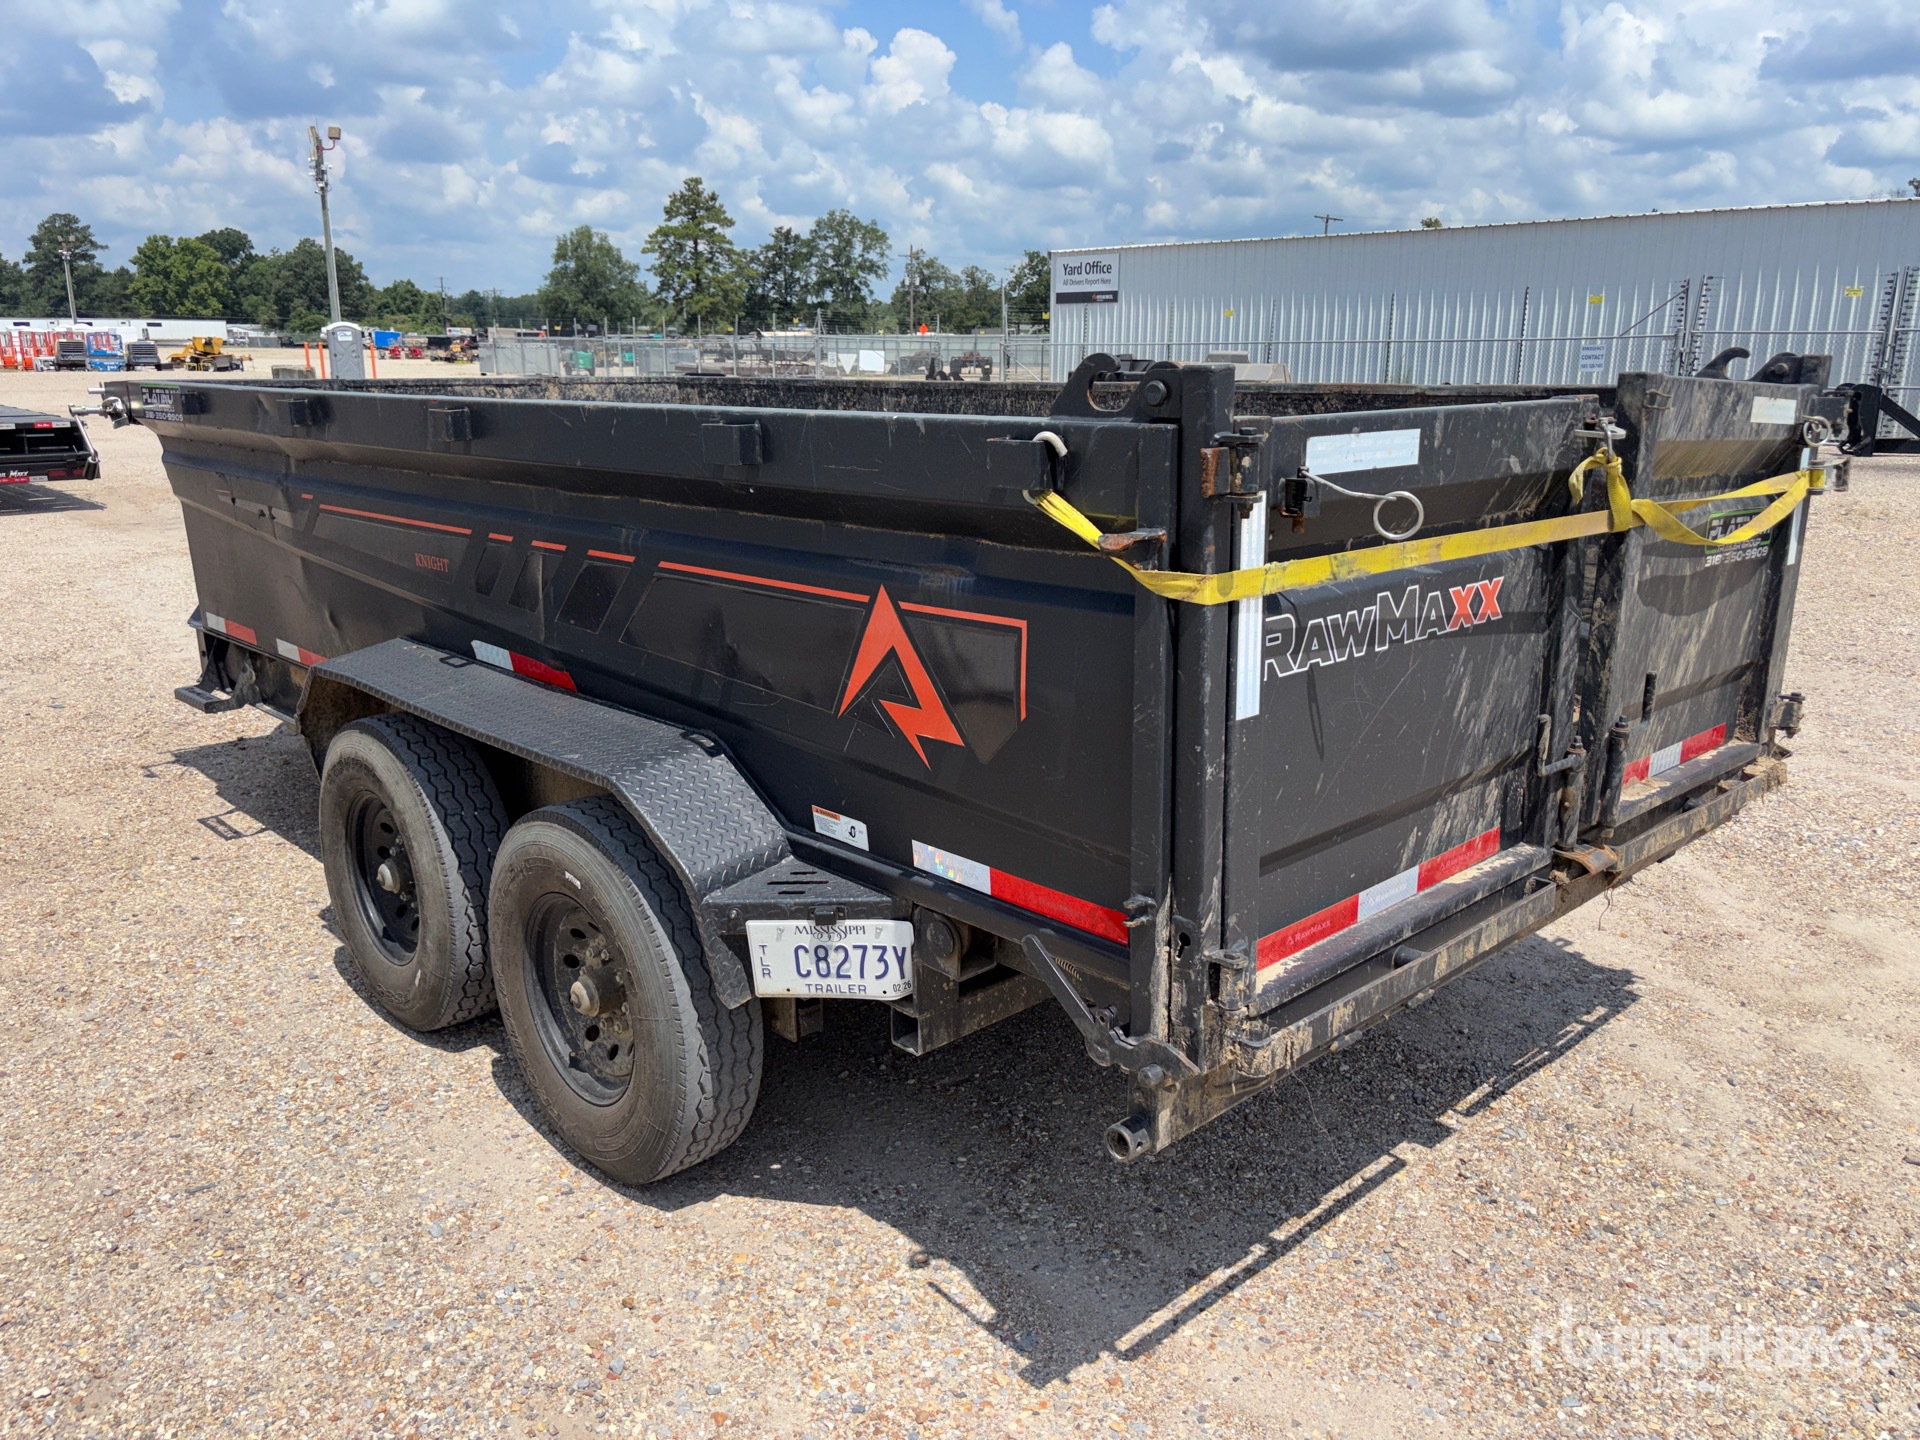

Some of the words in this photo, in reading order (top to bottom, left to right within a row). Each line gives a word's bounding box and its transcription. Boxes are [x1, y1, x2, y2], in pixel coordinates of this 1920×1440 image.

[1063, 262, 1083, 276] Yard
[1085, 261, 1112, 275] Office
[1085, 278, 1100, 286] Report
[1101, 277, 1112, 285] Here
[415, 552, 449, 573] KNIGHT
[794, 925, 866, 942] MISSISSIPPI
[794, 944, 907, 980] C8273Y
[805, 983, 867, 994] TRAILER
